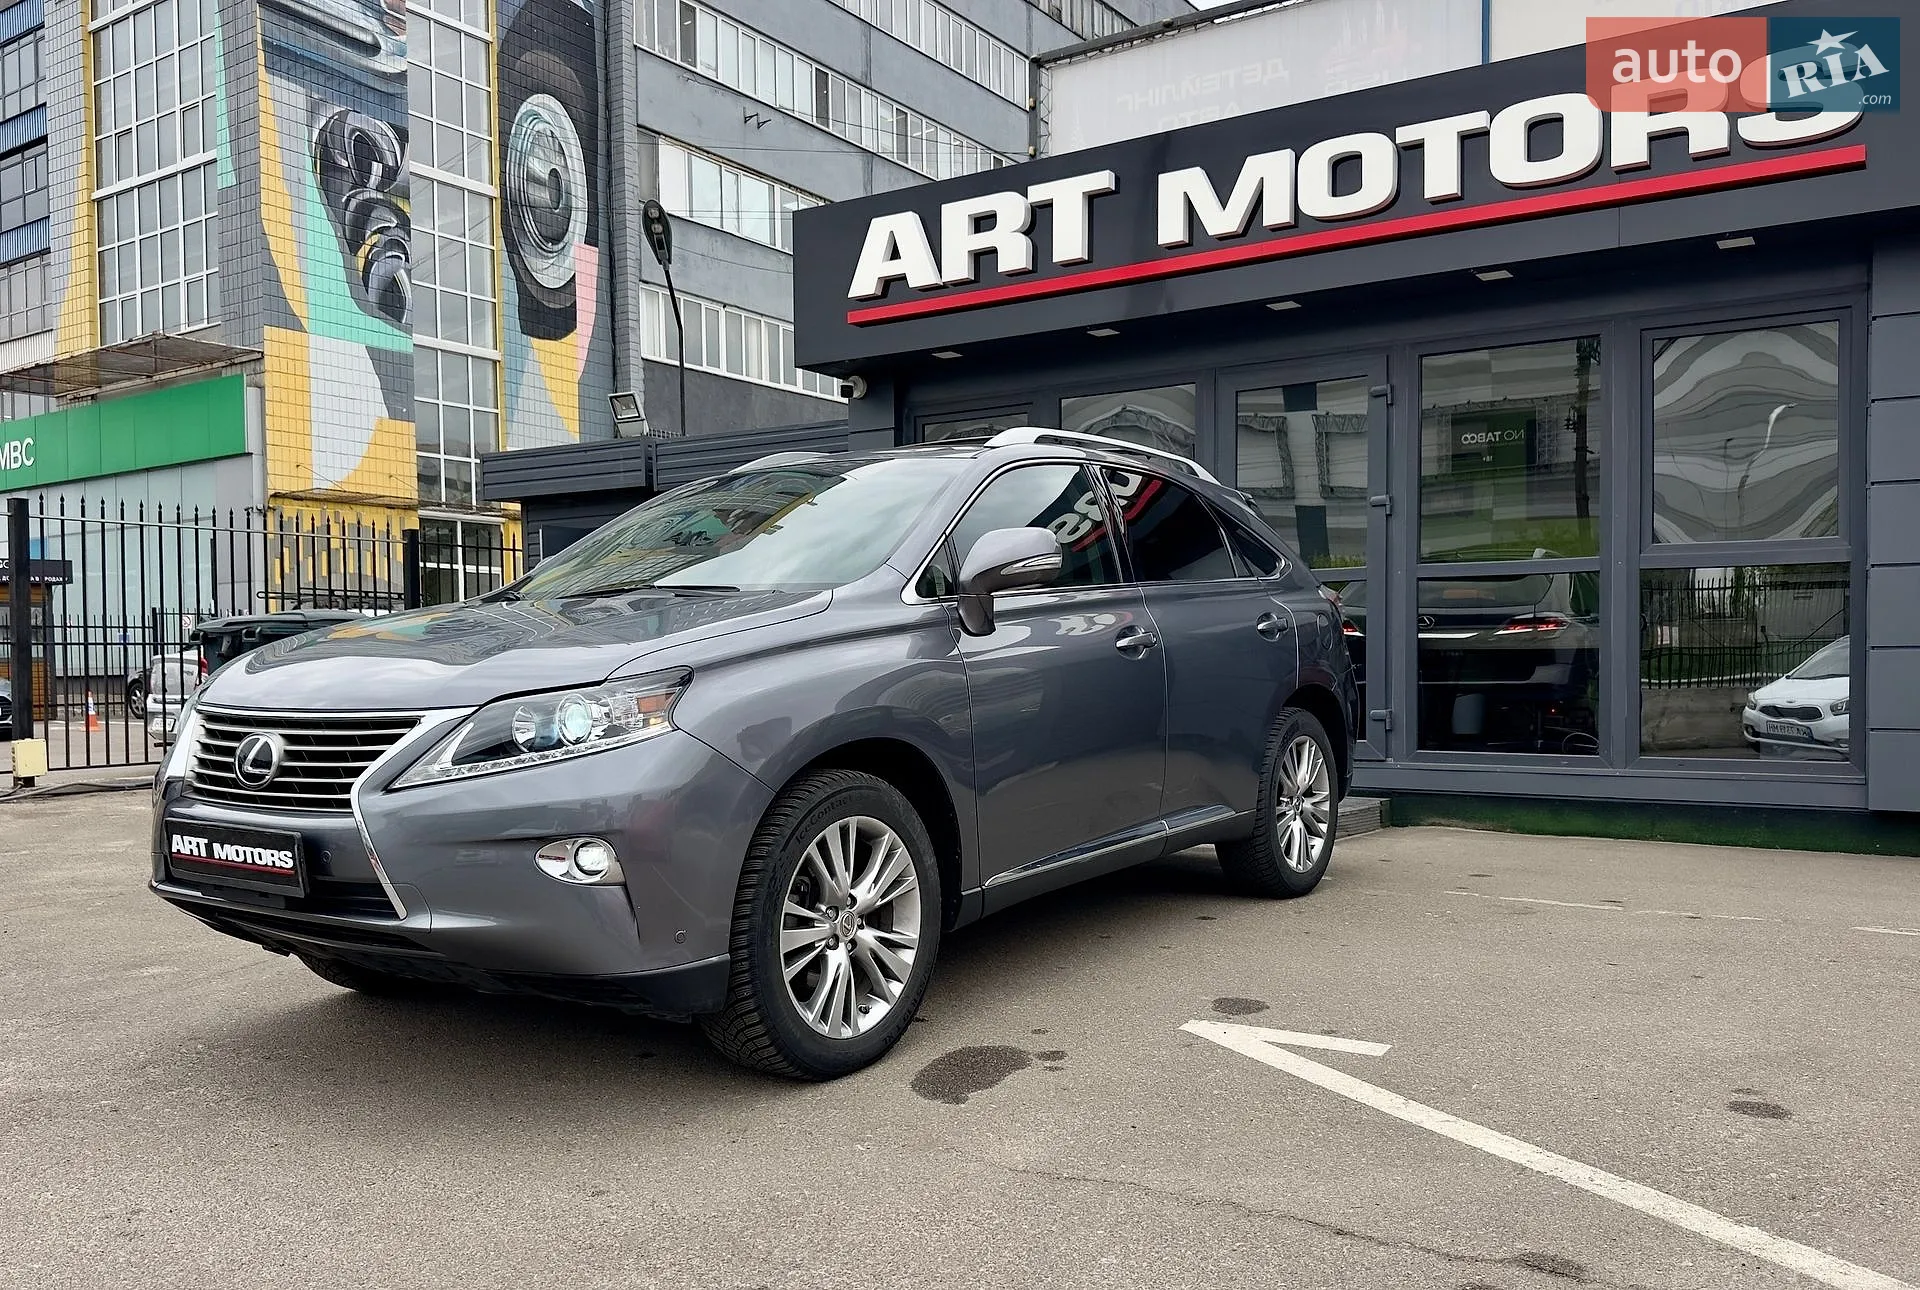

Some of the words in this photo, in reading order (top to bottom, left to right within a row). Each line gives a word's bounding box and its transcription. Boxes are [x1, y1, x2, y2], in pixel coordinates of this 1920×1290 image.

[847, 169, 1116, 300] ART
[1157, 42, 1866, 250] MOTORS
[171, 834, 208, 857] ART
[212, 842, 294, 869] MOTORS
